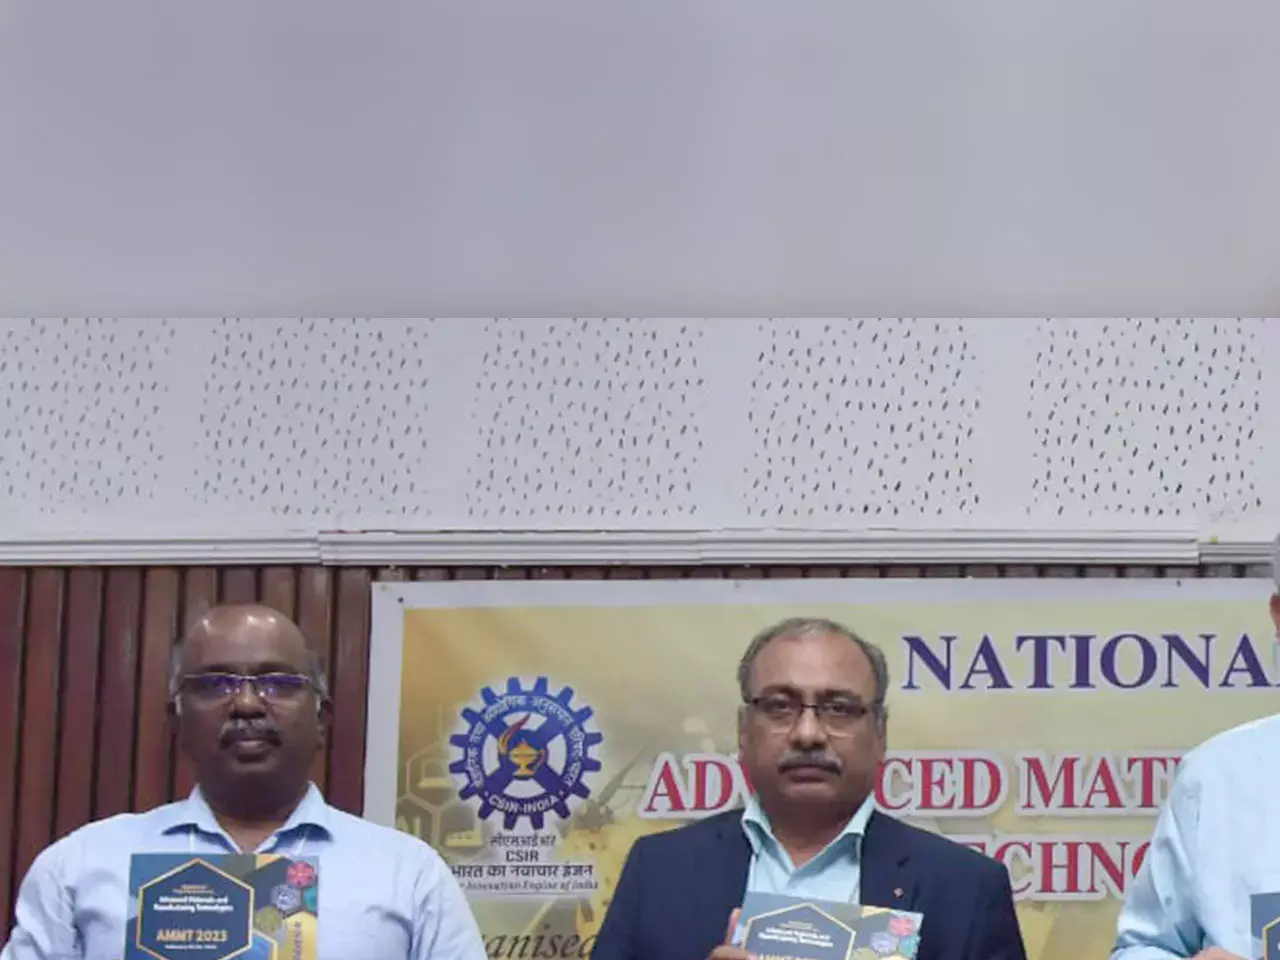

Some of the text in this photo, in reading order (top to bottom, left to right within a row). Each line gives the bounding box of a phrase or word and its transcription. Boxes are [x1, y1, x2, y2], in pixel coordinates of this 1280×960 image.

[643, 756, 1001, 809] ADCED
[506, 850, 539, 862] CSIR
[157, 928, 228, 941] AMMT 2023
